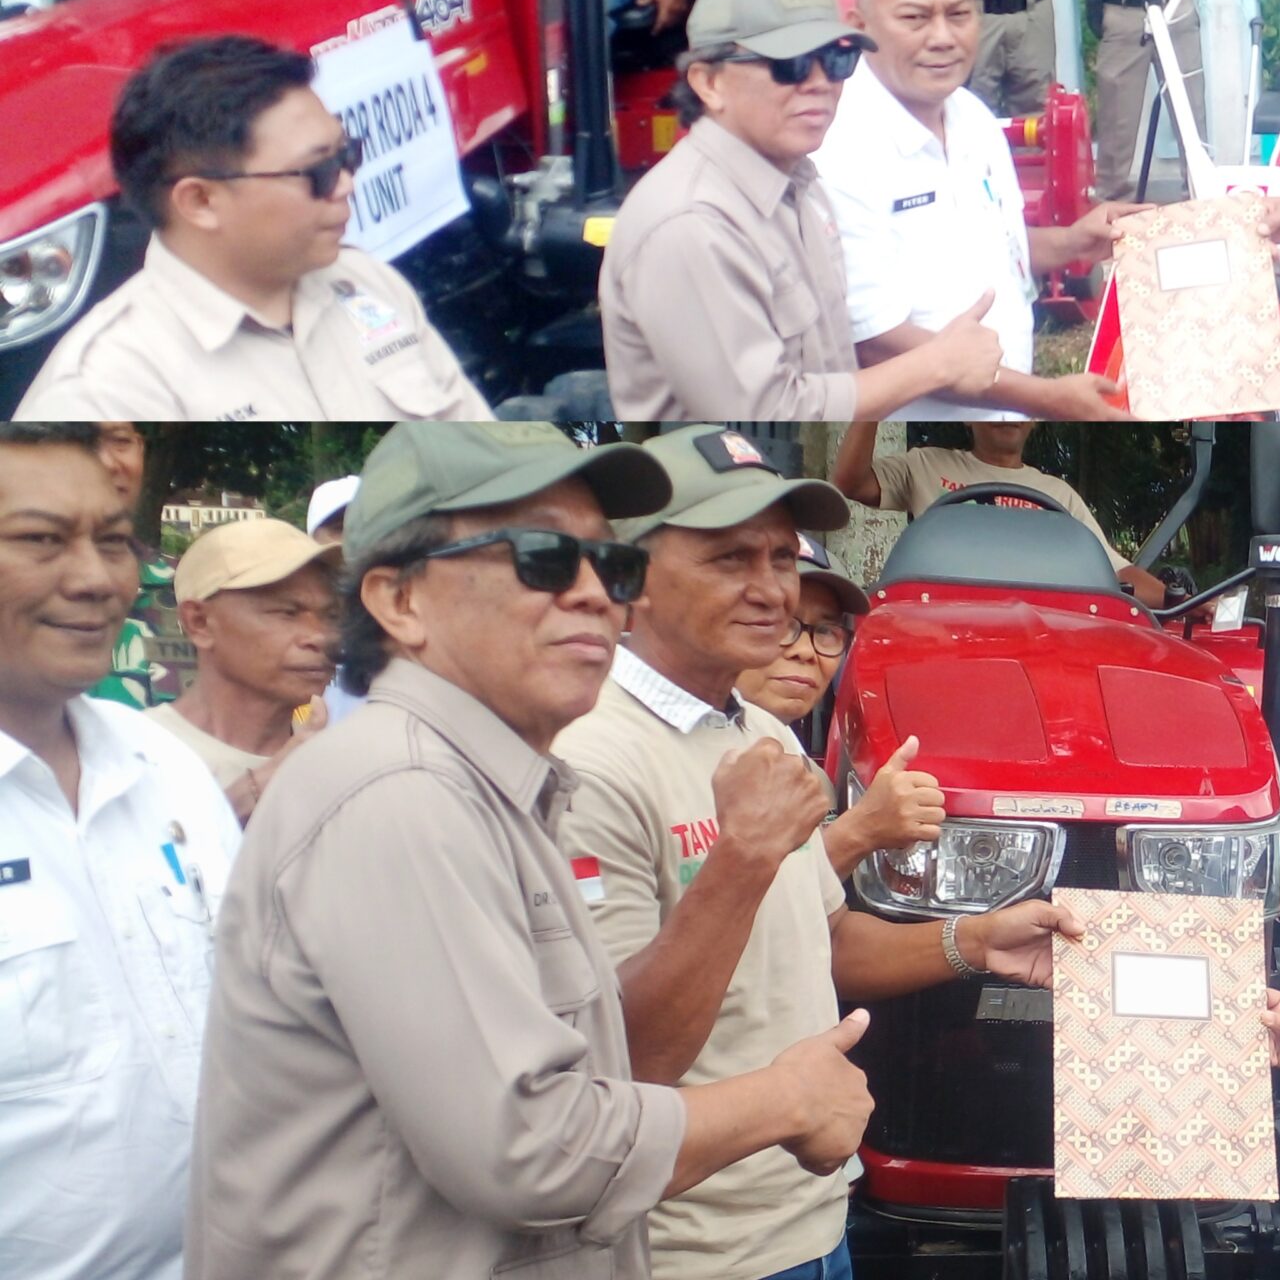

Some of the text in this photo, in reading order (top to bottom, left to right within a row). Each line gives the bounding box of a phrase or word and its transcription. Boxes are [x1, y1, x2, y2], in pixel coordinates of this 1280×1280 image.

[370, 77, 427, 155] RODA
[422, 72, 439, 127] 4
[362, 163, 408, 224] UNIT
